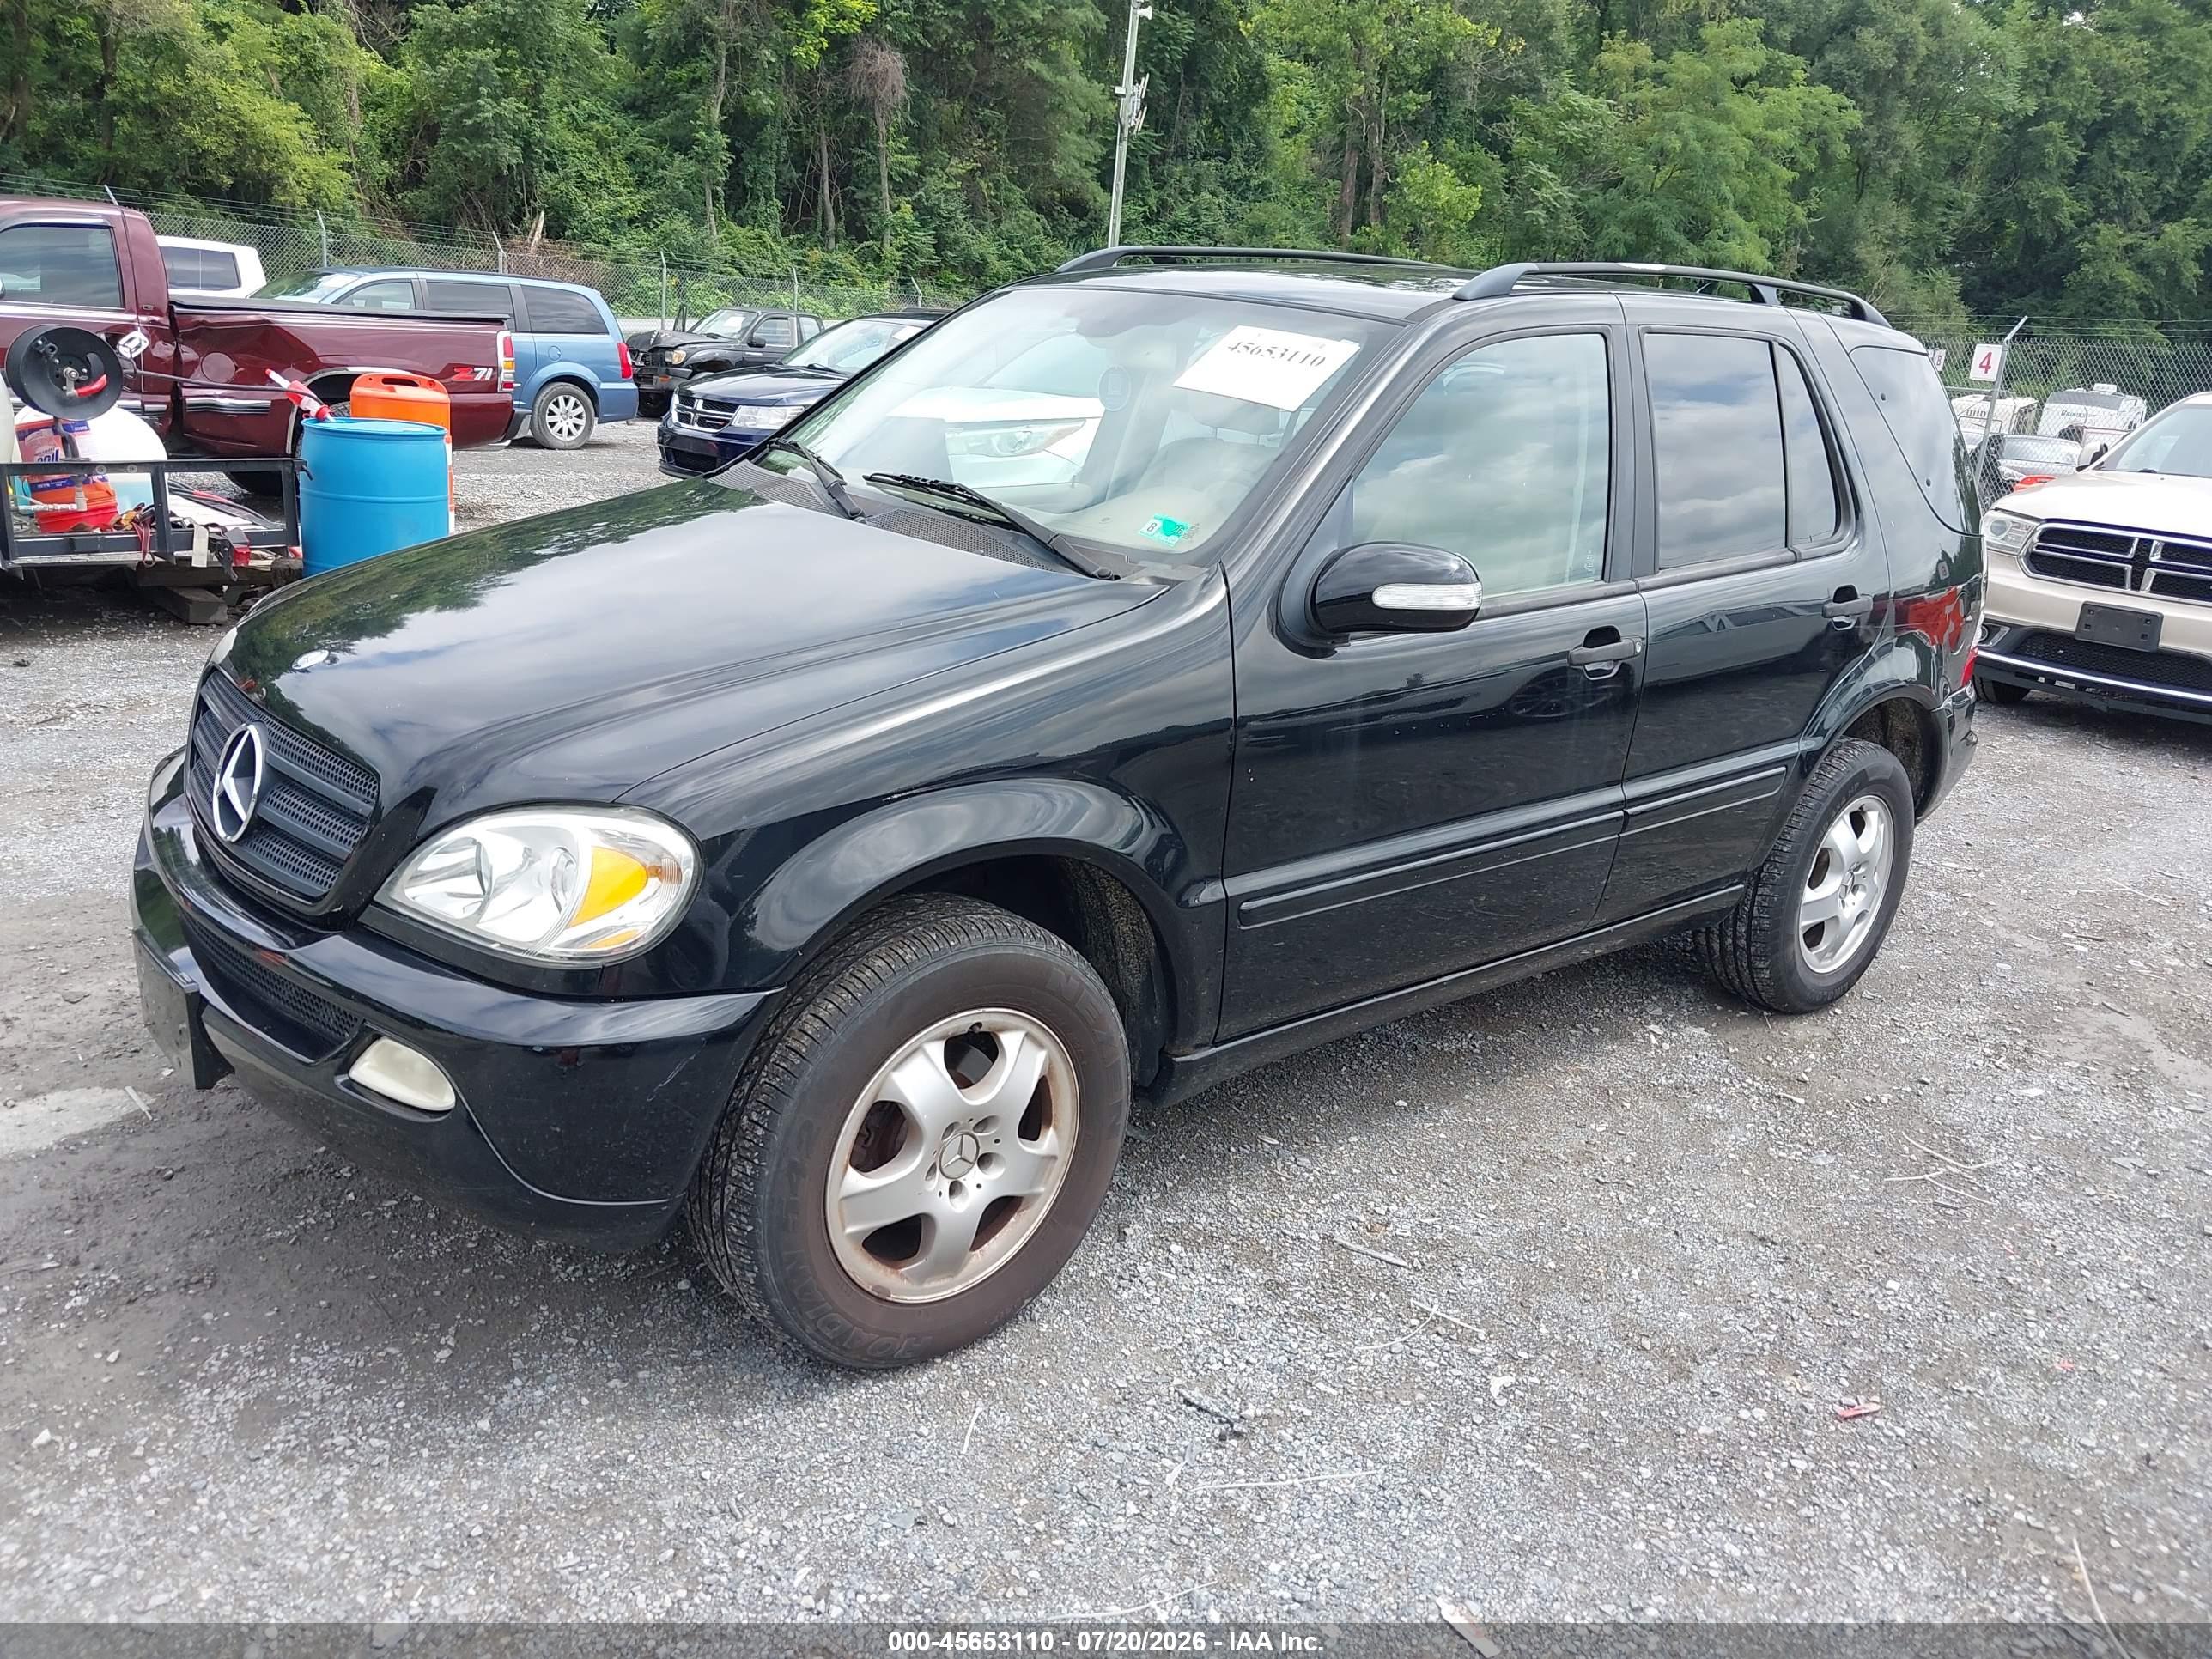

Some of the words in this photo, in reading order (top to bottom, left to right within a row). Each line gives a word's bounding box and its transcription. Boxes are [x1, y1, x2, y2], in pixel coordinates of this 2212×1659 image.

[1228, 342, 1326, 367] 45653110
[1978, 351, 1993, 374] 4
[452, 367, 494, 382] Z71
[1146, 522, 1158, 532] 8
[780, 1247, 933, 1360] ROADIAN
